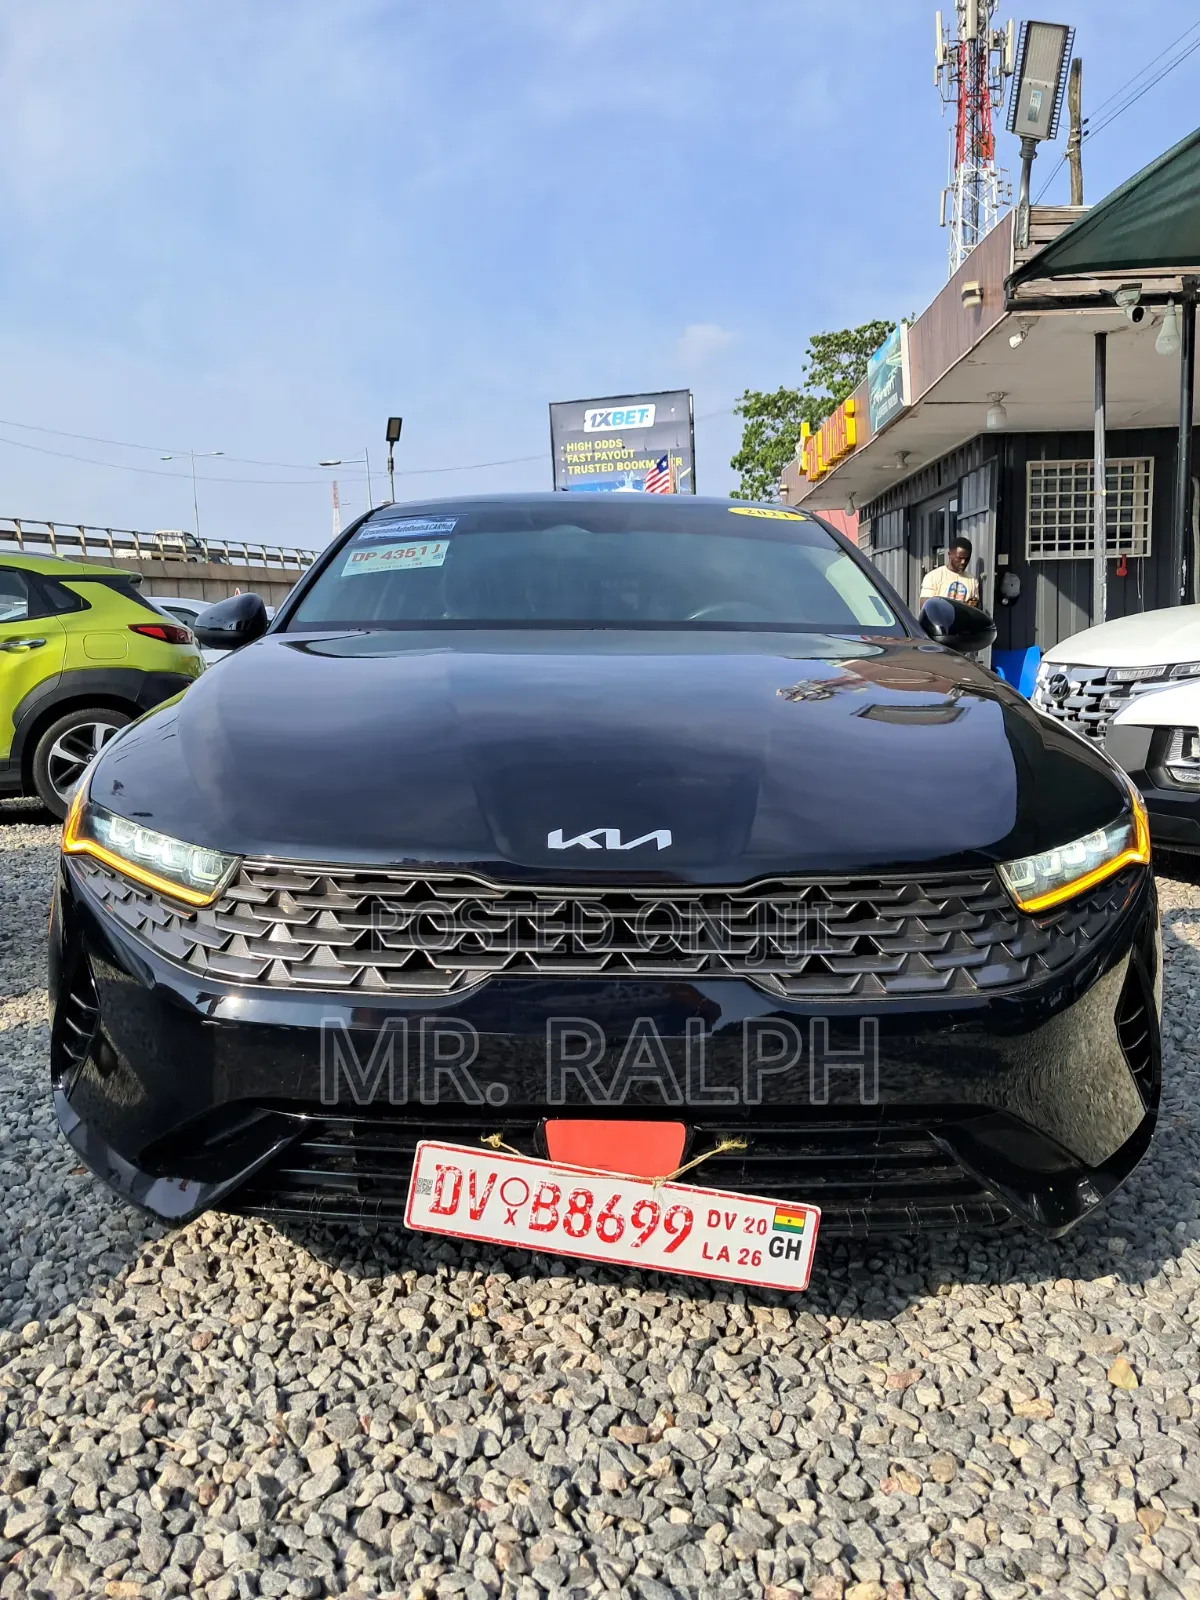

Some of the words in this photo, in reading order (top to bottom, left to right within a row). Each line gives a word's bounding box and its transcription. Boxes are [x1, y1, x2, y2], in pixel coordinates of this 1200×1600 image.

[590, 408, 649, 428] 1XBET
[566, 441, 592, 453] HIGH
[594, 438, 623, 450] ODDS
[566, 452, 593, 464] FAST
[594, 449, 635, 462] PAYOUT
[567, 463, 614, 475] TRUSTED
[351, 551, 378, 563] DP
[548, 828, 672, 850] KIA
[428, 1163, 498, 1221] DV
[528, 1179, 694, 1253] B8699
[706, 1208, 738, 1231] DV
[743, 1216, 768, 1236] 20
[701, 1241, 730, 1263] LA
[737, 1247, 762, 1267] 26
[768, 1235, 803, 1261] GH
